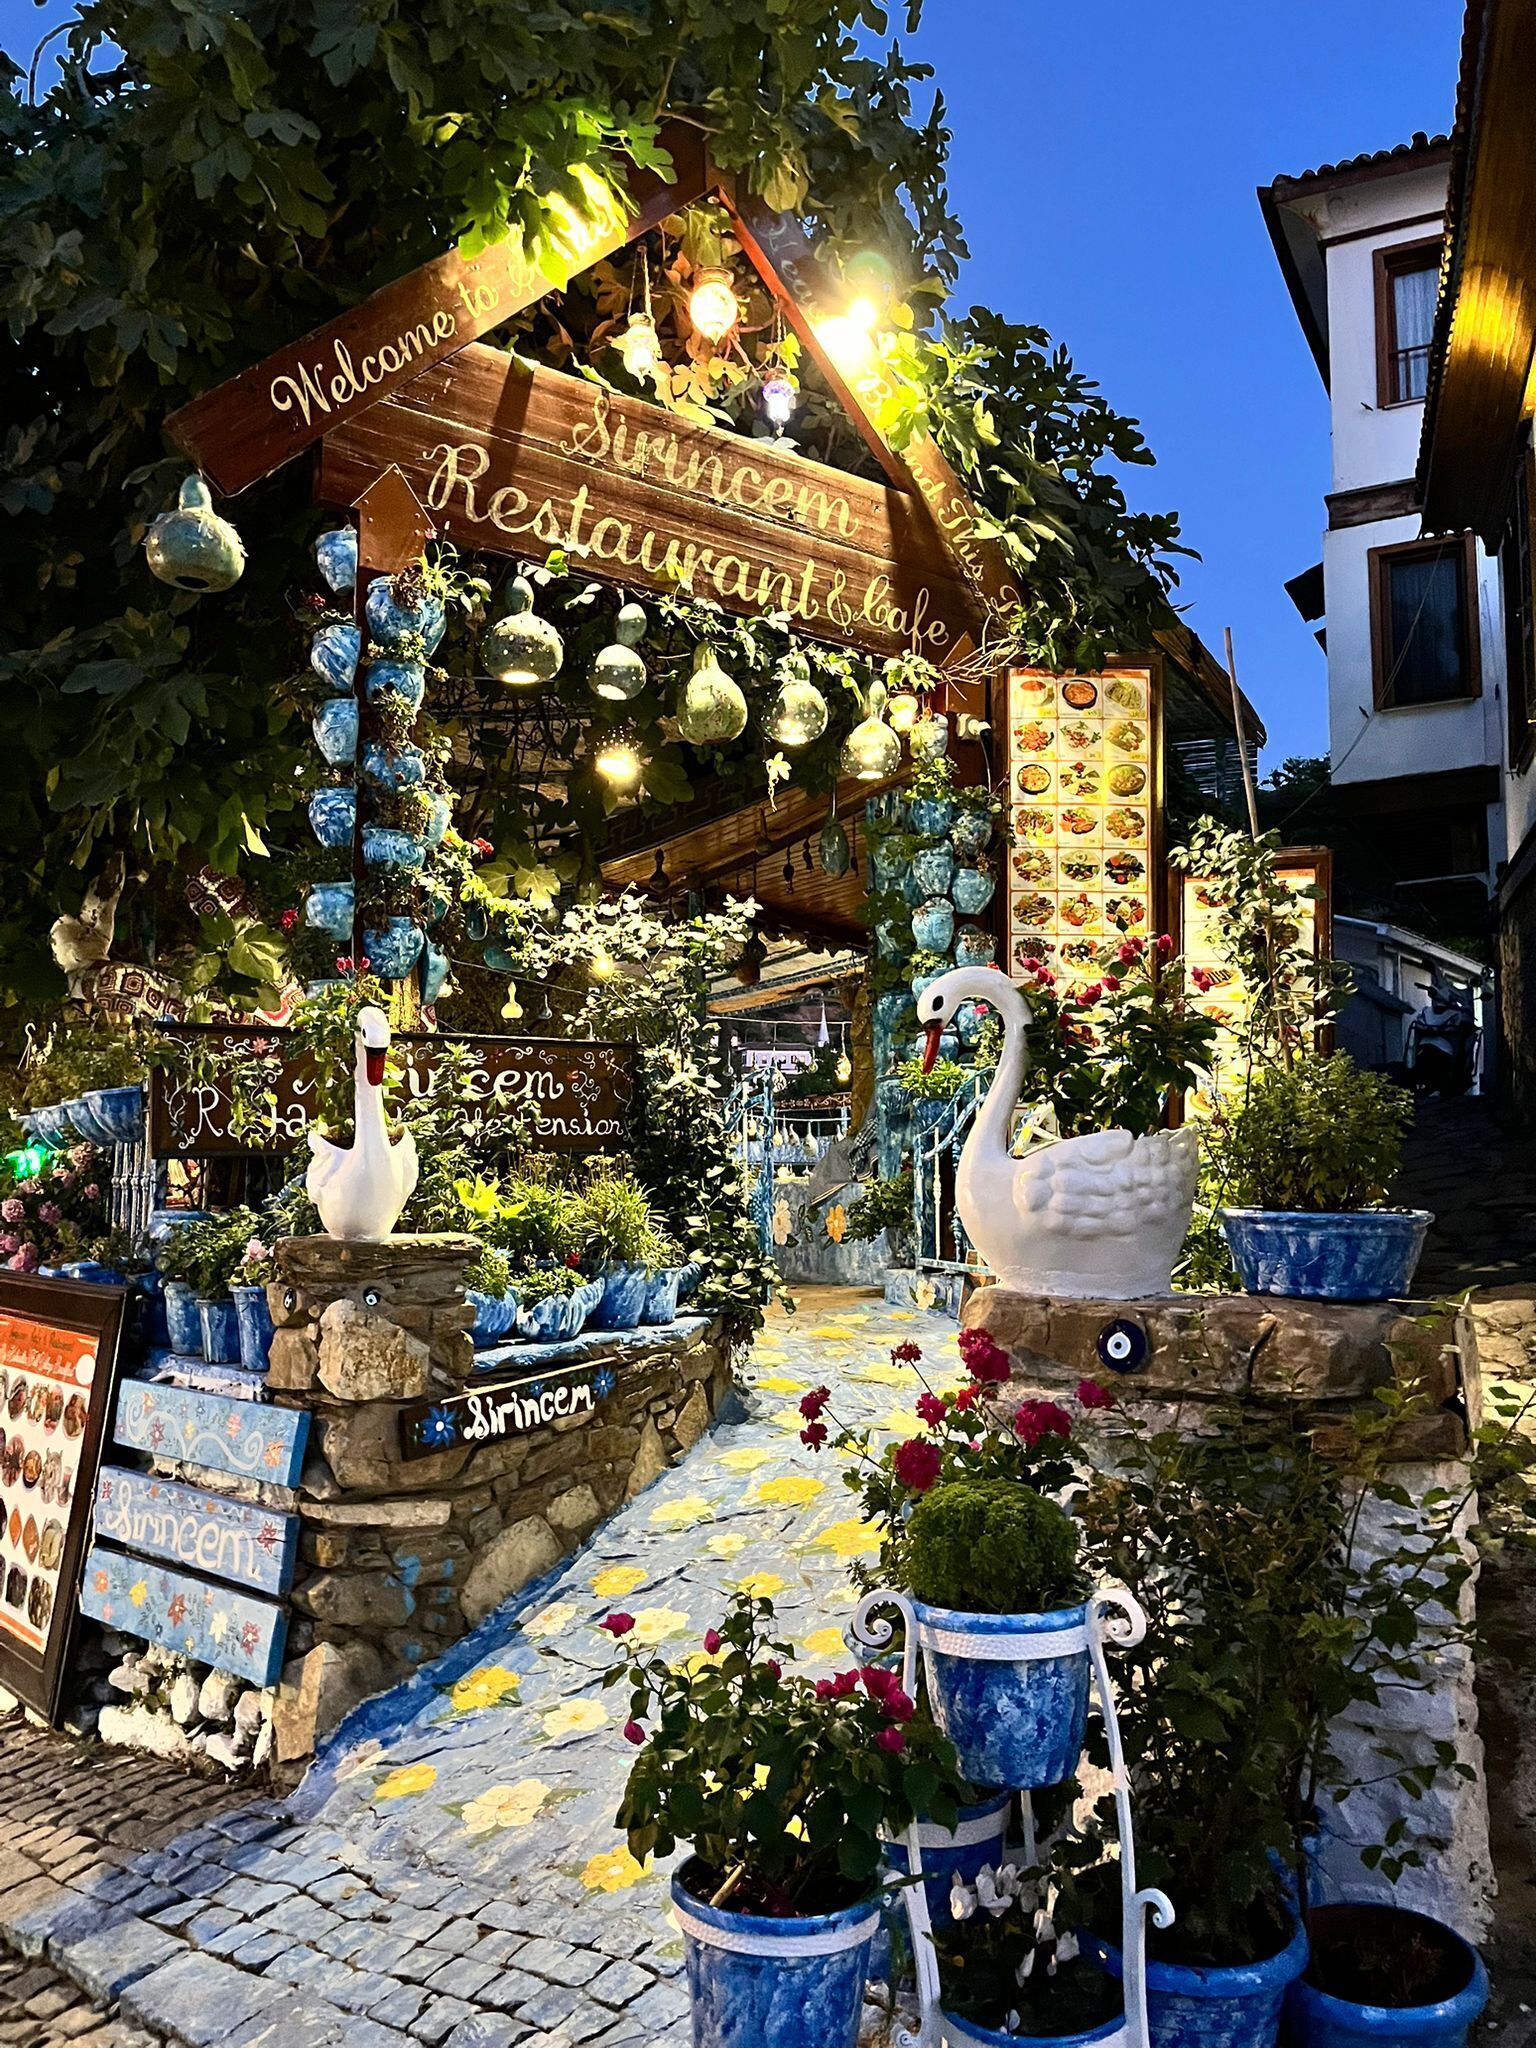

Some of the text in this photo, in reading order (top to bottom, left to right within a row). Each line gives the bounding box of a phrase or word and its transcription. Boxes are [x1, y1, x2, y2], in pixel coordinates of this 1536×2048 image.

[270, 281, 499, 426] Welcome to
[422, 442, 820, 621] Restaurant
[826, 568, 854, 637] &
[853, 574, 950, 657] Cafe
